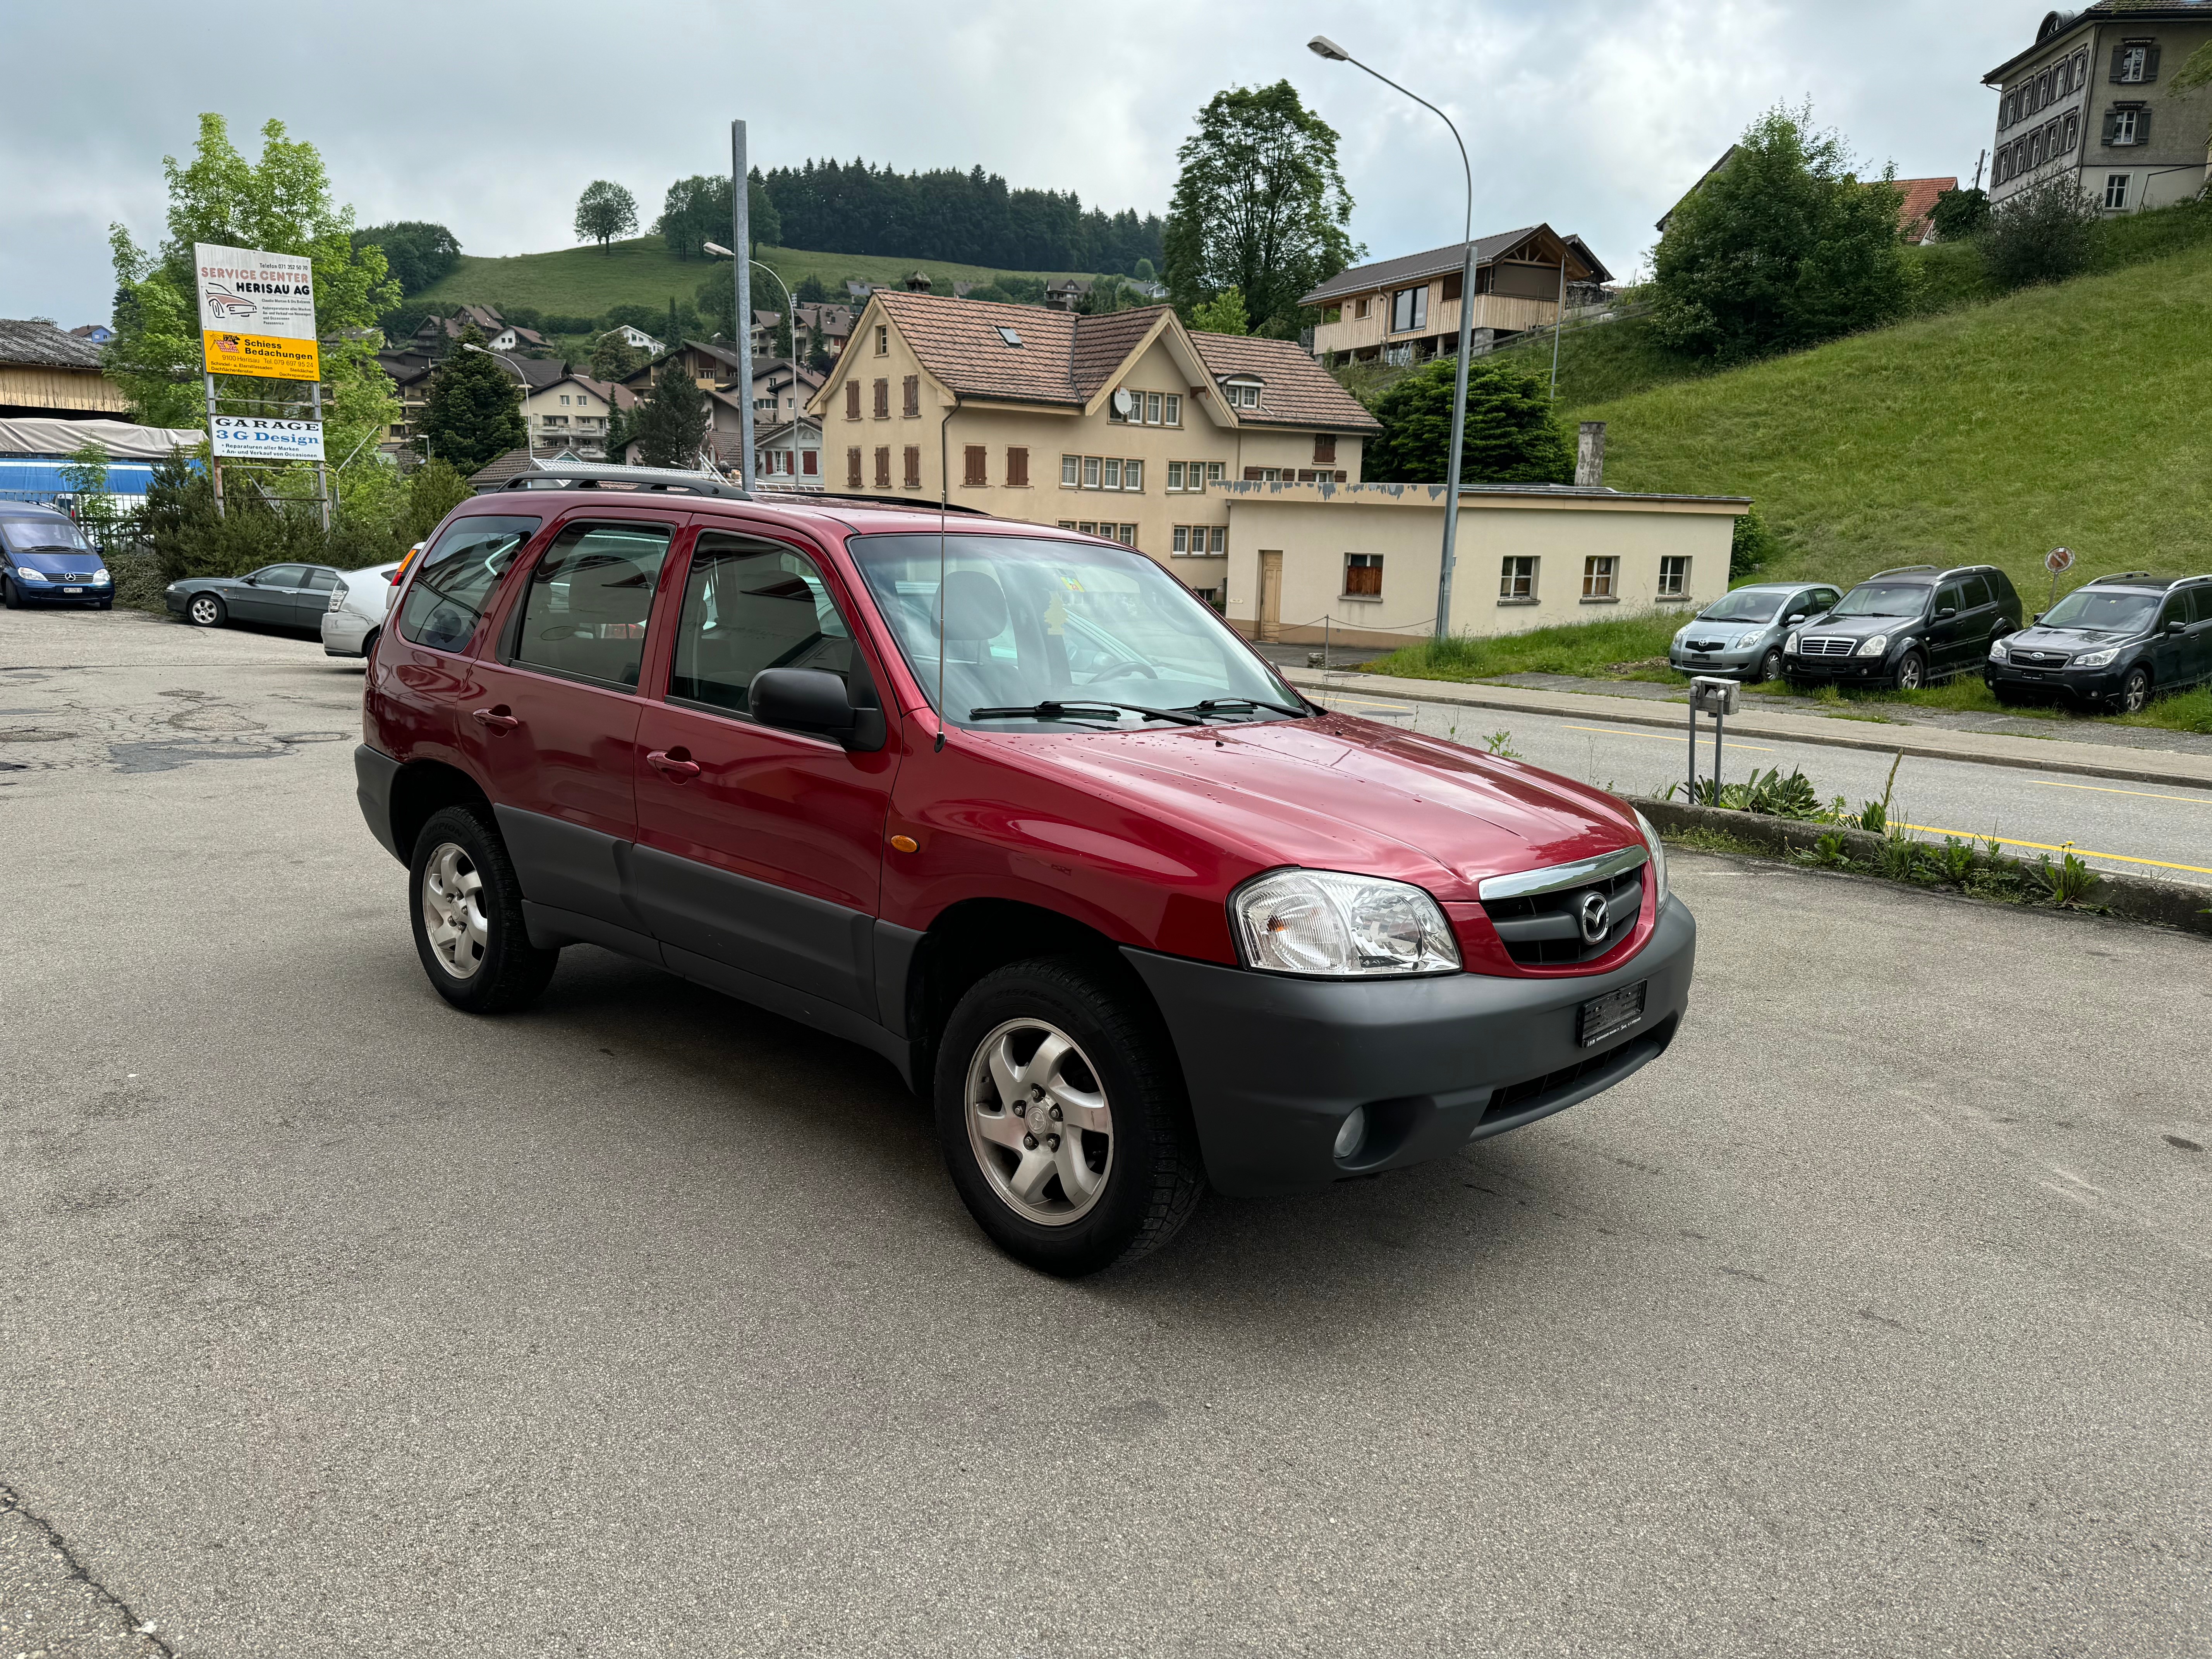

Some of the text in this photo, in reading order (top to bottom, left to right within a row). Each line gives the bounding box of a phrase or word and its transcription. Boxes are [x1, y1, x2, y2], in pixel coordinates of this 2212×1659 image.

[201, 267, 308, 283] SERVICE CENTER
[236, 282, 310, 295] HERISAU AG
[244, 339, 282, 349] Schiess
[245, 347, 313, 360] Bedachungen
[215, 418, 319, 431] GARAGE
[216, 430, 319, 446] 3 G Design
